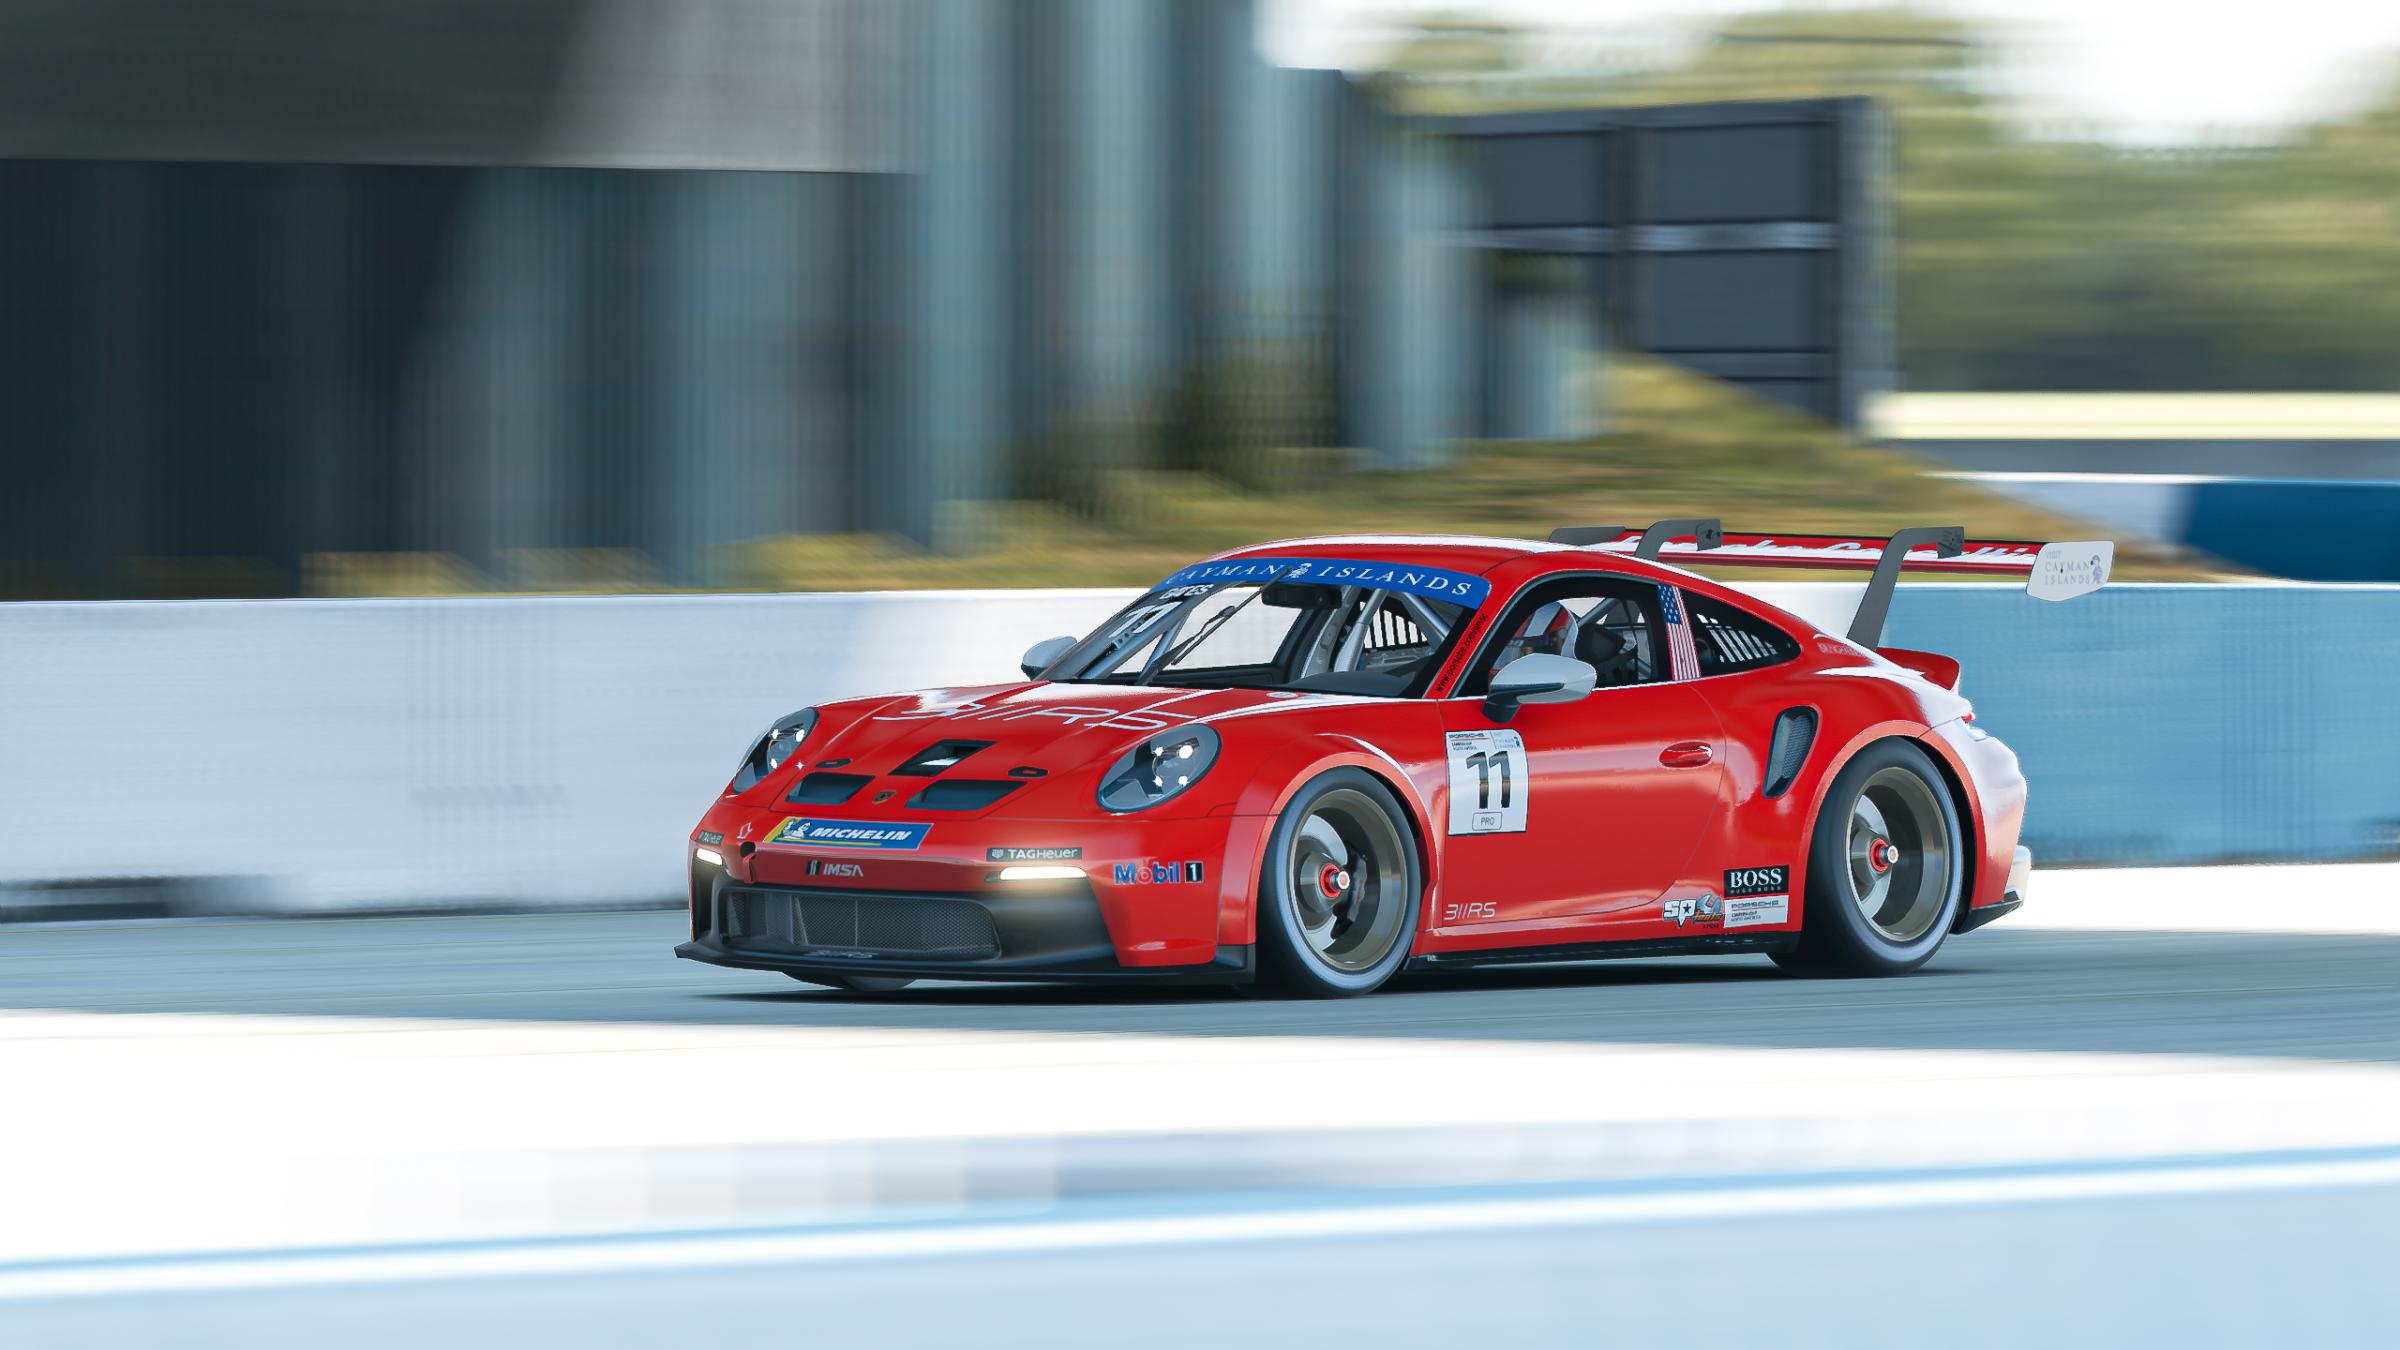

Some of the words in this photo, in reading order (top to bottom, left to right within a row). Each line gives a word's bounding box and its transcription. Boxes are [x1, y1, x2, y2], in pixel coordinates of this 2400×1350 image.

[2045, 561, 2090, 572] CAYMAN
[1317, 566, 1472, 596] ISLANDS
[2045, 574, 2090, 585] ISLANDS
[1465, 750, 1511, 810] 11
[1480, 817, 1495, 826] PRO
[809, 826, 913, 842] MICHELIN
[822, 863, 864, 878] IMSA
[1113, 861, 1180, 885] Mobil
[1187, 862, 1201, 882] 1
[1730, 868, 1782, 888] BOSS
[1731, 900, 1779, 909] PORSCHE
